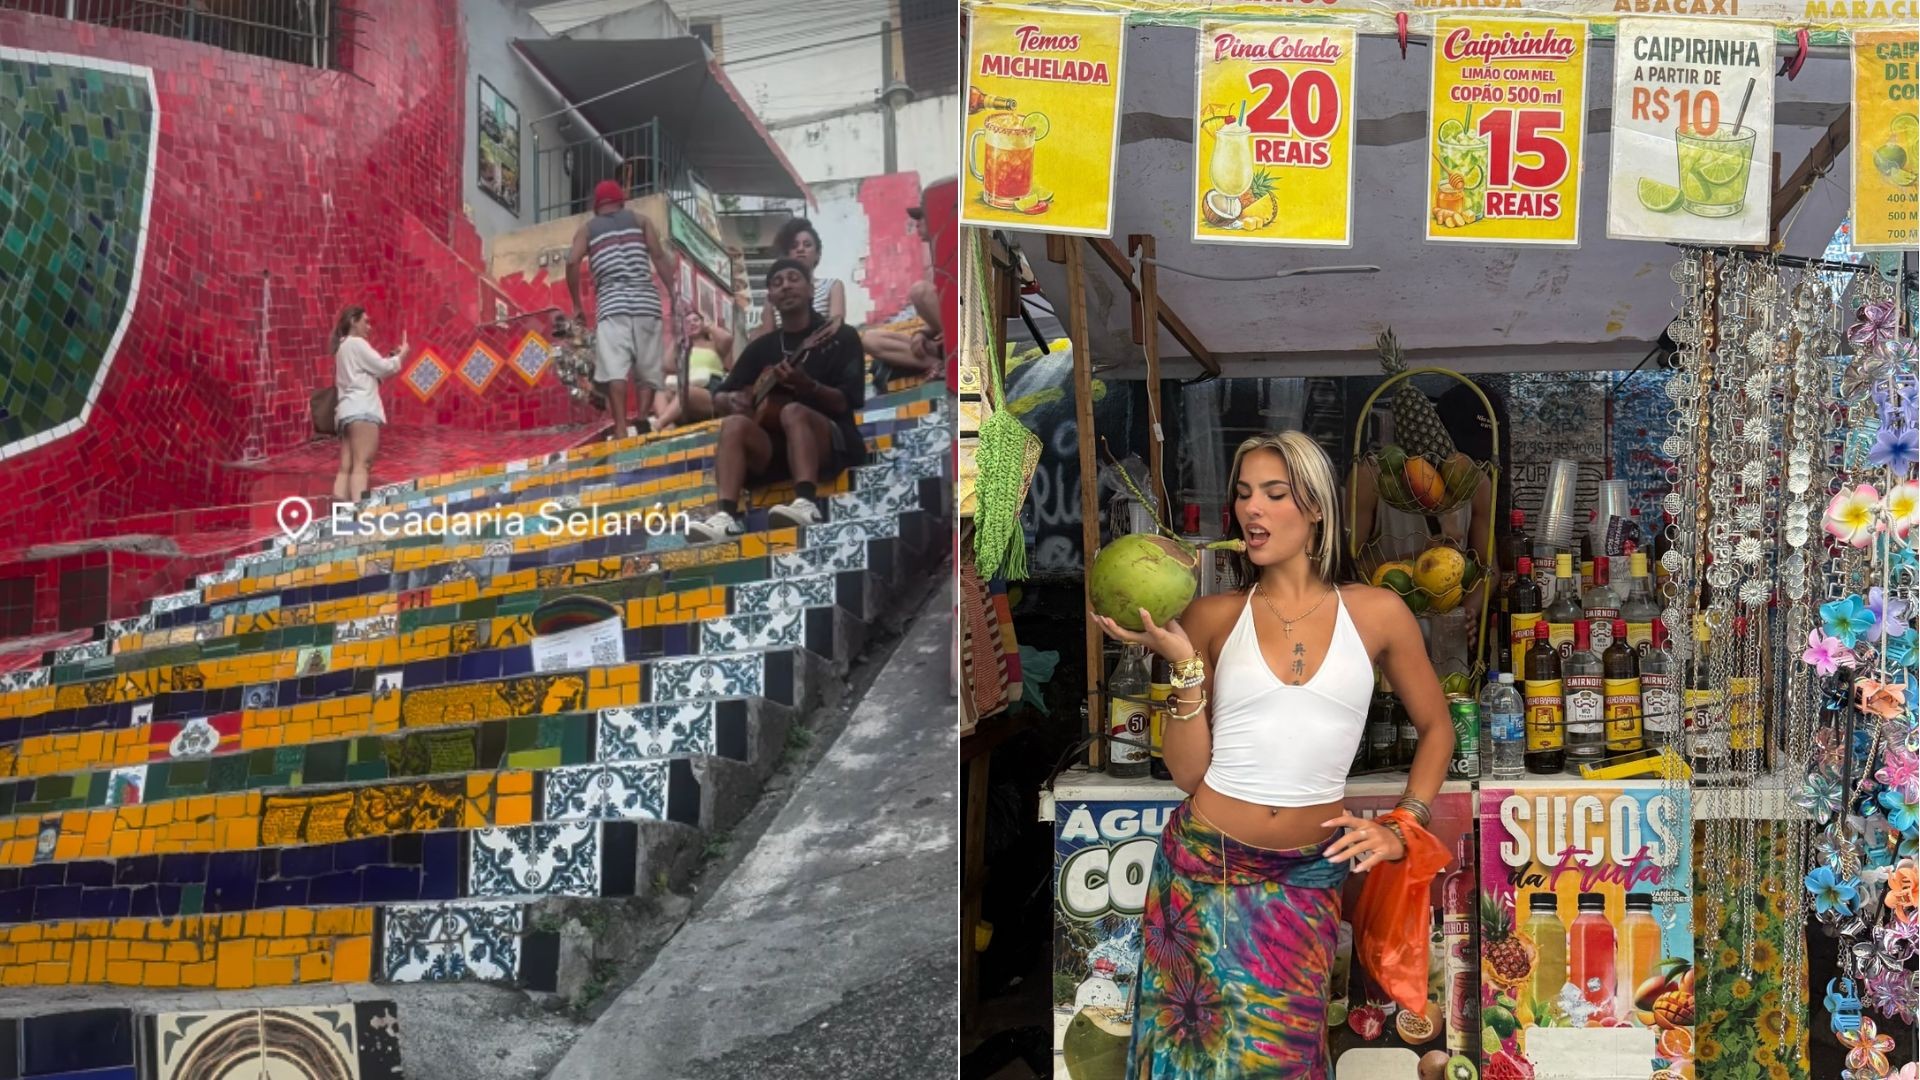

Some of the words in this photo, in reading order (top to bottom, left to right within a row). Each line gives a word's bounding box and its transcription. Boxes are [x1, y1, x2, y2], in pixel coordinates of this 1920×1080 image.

[1613, 0, 1739, 16] ABACAXI
[1015, 25, 1080, 51] Temos
[1267, 36, 1342, 59] Colada
[1443, 28, 1576, 63] Caipirinha
[1634, 35, 1761, 67] CAIPIRINHA
[980, 54, 1109, 83] MICHELADA
[1462, 66, 1501, 80] LIMÃO
[1503, 69, 1530, 80] COM
[1532, 70, 1556, 81] MEL
[1634, 66, 1644, 81] A
[1648, 66, 1699, 84] PARTIR
[1704, 70, 1721, 85] DE
[1885, 63, 1910, 81] DE
[1246, 68, 1339, 138] 20
[1451, 84, 1504, 101] COPÃO
[1508, 86, 1541, 103] 500
[1543, 89, 1562, 104] ml
[1255, 139, 1330, 165] REAIS
[1478, 109, 1568, 188] 15
[1486, 192, 1559, 217] REAIS
[1887, 193, 1906, 203] 400
[1888, 211, 1906, 221] 500
[1887, 229, 1906, 239] 700
[1585, 609, 1619, 619] SMIRNOFF
[1561, 644, 1573, 658] 51
[1639, 643, 1650, 657] 51
[1131, 716, 1144, 731] 51
[1500, 794, 1678, 868] SUCOS
[1507, 861, 1547, 889] da
[1550, 844, 1664, 893] Fruta
